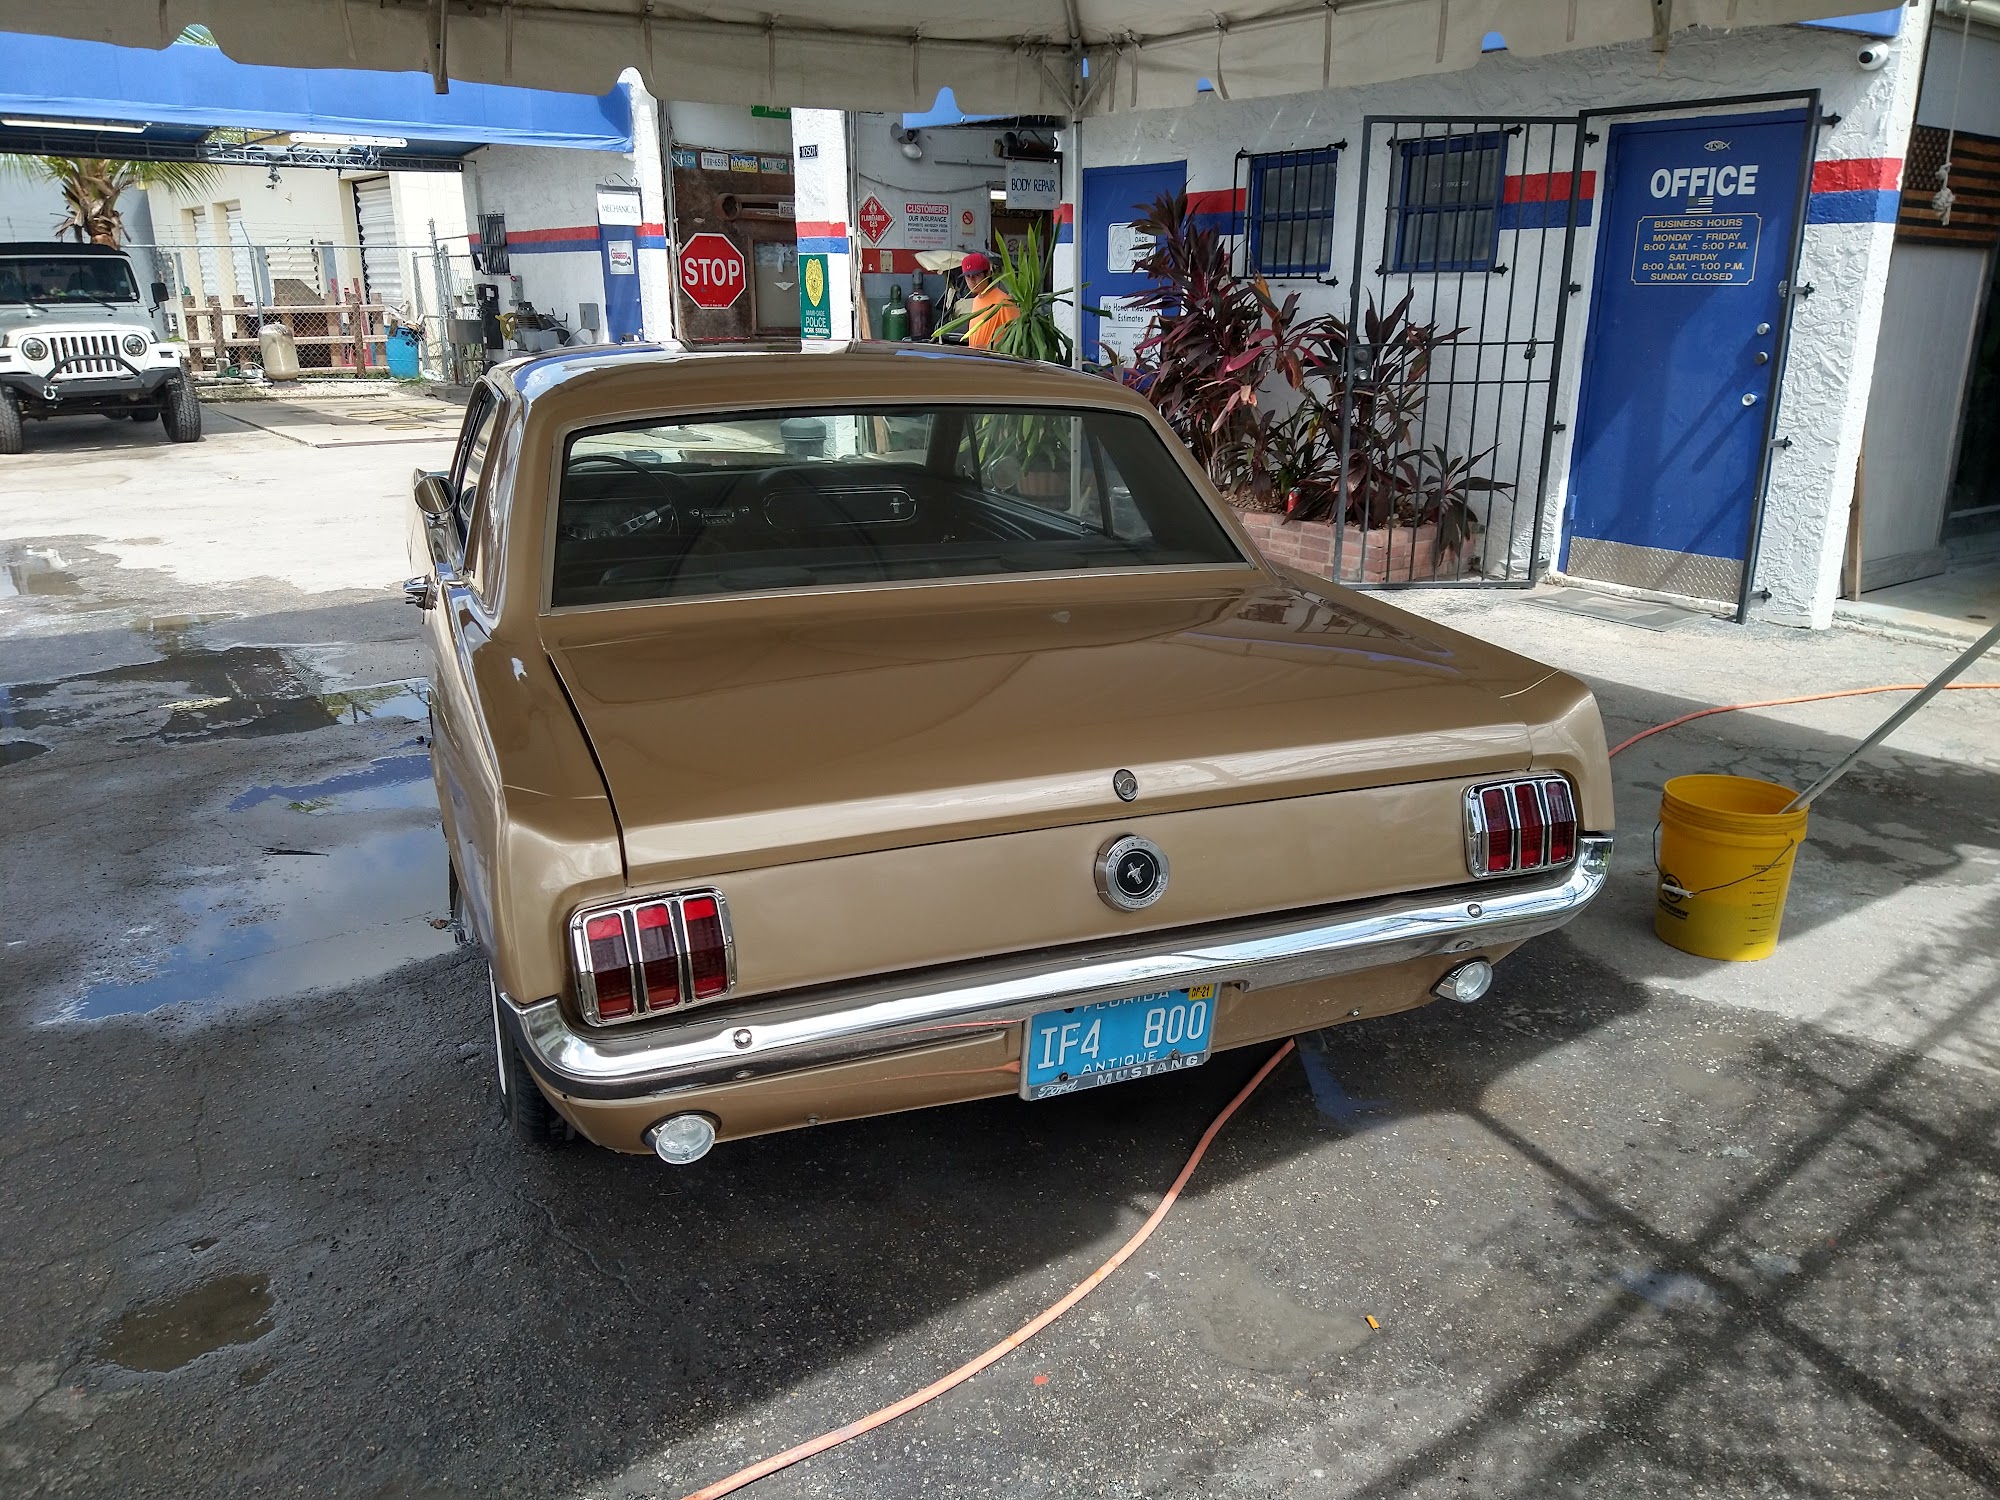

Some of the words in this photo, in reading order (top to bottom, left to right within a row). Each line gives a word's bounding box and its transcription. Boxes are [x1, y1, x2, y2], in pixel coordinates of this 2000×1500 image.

[801, 145, 816, 157] 10501
[1011, 178, 1031, 191] BODY
[1033, 179, 1056, 192] REPAIR
[1650, 164, 1759, 199] OFFICE
[602, 204, 638, 213] MECHANICAL
[906, 204, 948, 214] CUSTOMERS
[920, 215, 947, 223] INSURANCE
[1654, 219, 1703, 229] BUSINESS
[1707, 218, 1743, 227] HOURS
[871, 230, 877, 238] 2
[1652, 233, 1694, 242] MONDAY
[1706, 232, 1741, 241] FRIDAY
[1643, 243, 1665, 251] 8:00
[1702, 242, 1724, 250] 5:00
[1728, 242, 1749, 250] P.M.
[1669, 253, 1718, 261] SATURDAY
[1701, 262, 1720, 270] 1:00
[1724, 262, 1745, 270] P.M.
[684, 257, 740, 287] STOP
[1650, 272, 1688, 280] SUNDAY
[1692, 272, 1733, 280] CLOSED
[1113, 303, 1129, 312] Honor
[805, 316, 827, 328] POLICE
[1118, 313, 1144, 323] Estimates
[815, 327, 830, 335] STATION
[1037, 1018, 1102, 1070] IF4
[1143, 1001, 1207, 1049] 800
[1081, 1050, 1158, 1075] ANTIQUE
[1037, 1080, 1078, 1099] Ford
[1096, 1055, 1199, 1086] MUSTANG
